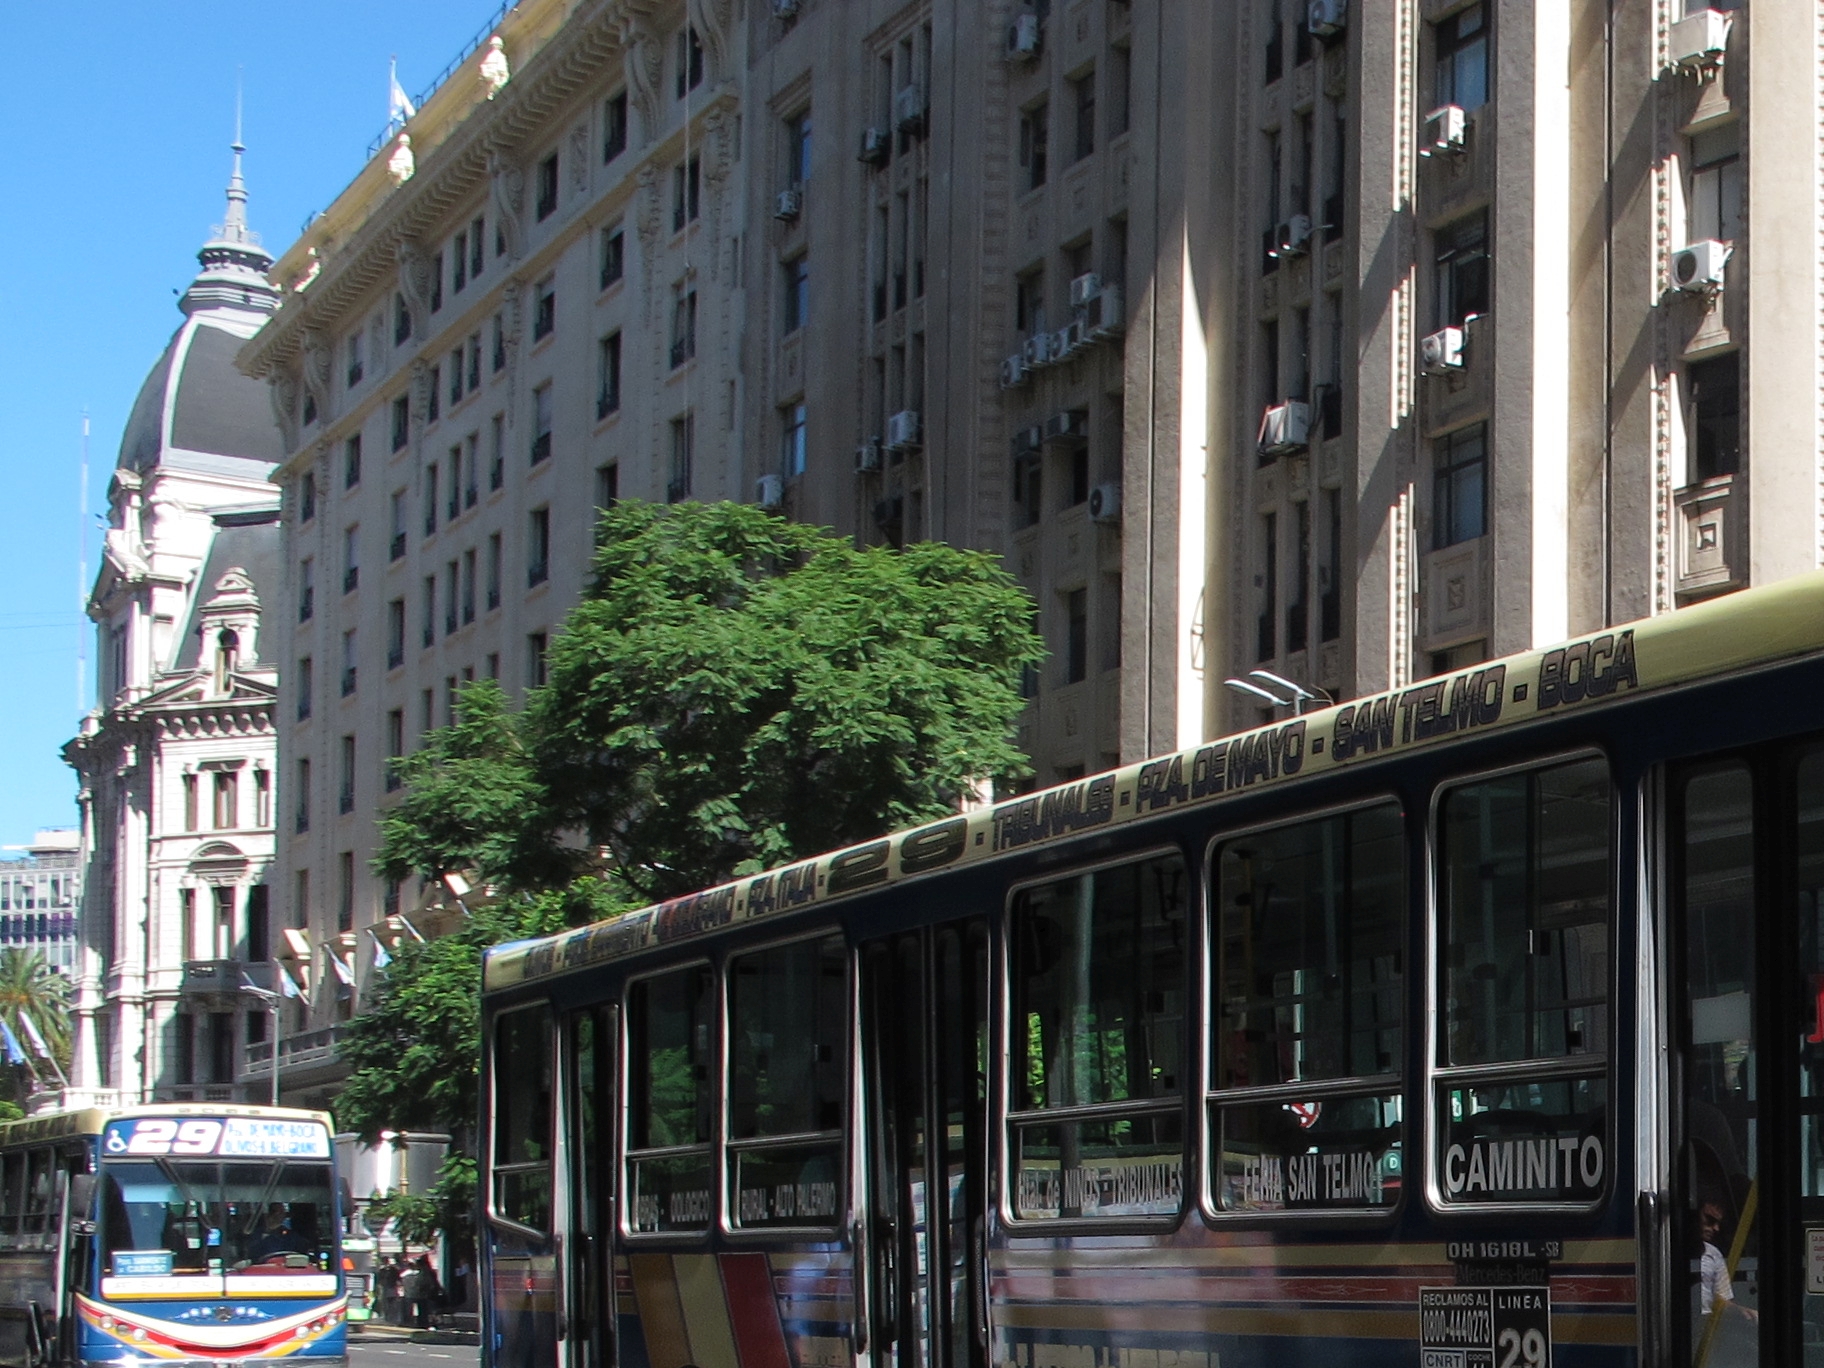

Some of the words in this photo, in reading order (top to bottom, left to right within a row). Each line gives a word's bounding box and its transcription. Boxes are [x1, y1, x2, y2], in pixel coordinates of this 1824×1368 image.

[994, 774, 1115, 852] TRIBUNALES
[1226, 720, 1305, 793] MAYO
[1332, 697, 1395, 762] SAN
[1402, 664, 1506, 745] TELMO
[1539, 629, 1639, 711] BOCA
[827, 818, 968, 896] 29
[128, 1120, 222, 1154] 29
[1244, 1153, 1282, 1201] FERIA
[1288, 1156, 1317, 1200] SAN
[1323, 1152, 1374, 1199] TELMO
[1446, 1135, 1603, 1193] CAMINITO
[1112, 1161, 1184, 1206] TRIBUNALES
[1458, 1264, 1546, 1284] Mercedes-Benz
[1423, 1294, 1475, 1307] RECLAMOS
[1477, 1293, 1489, 1306] AL
[1499, 1297, 1542, 1309] LINEA
[1423, 1310, 1490, 1343] 0800-4440273
[1426, 1355, 1461, 1367] CNRT
